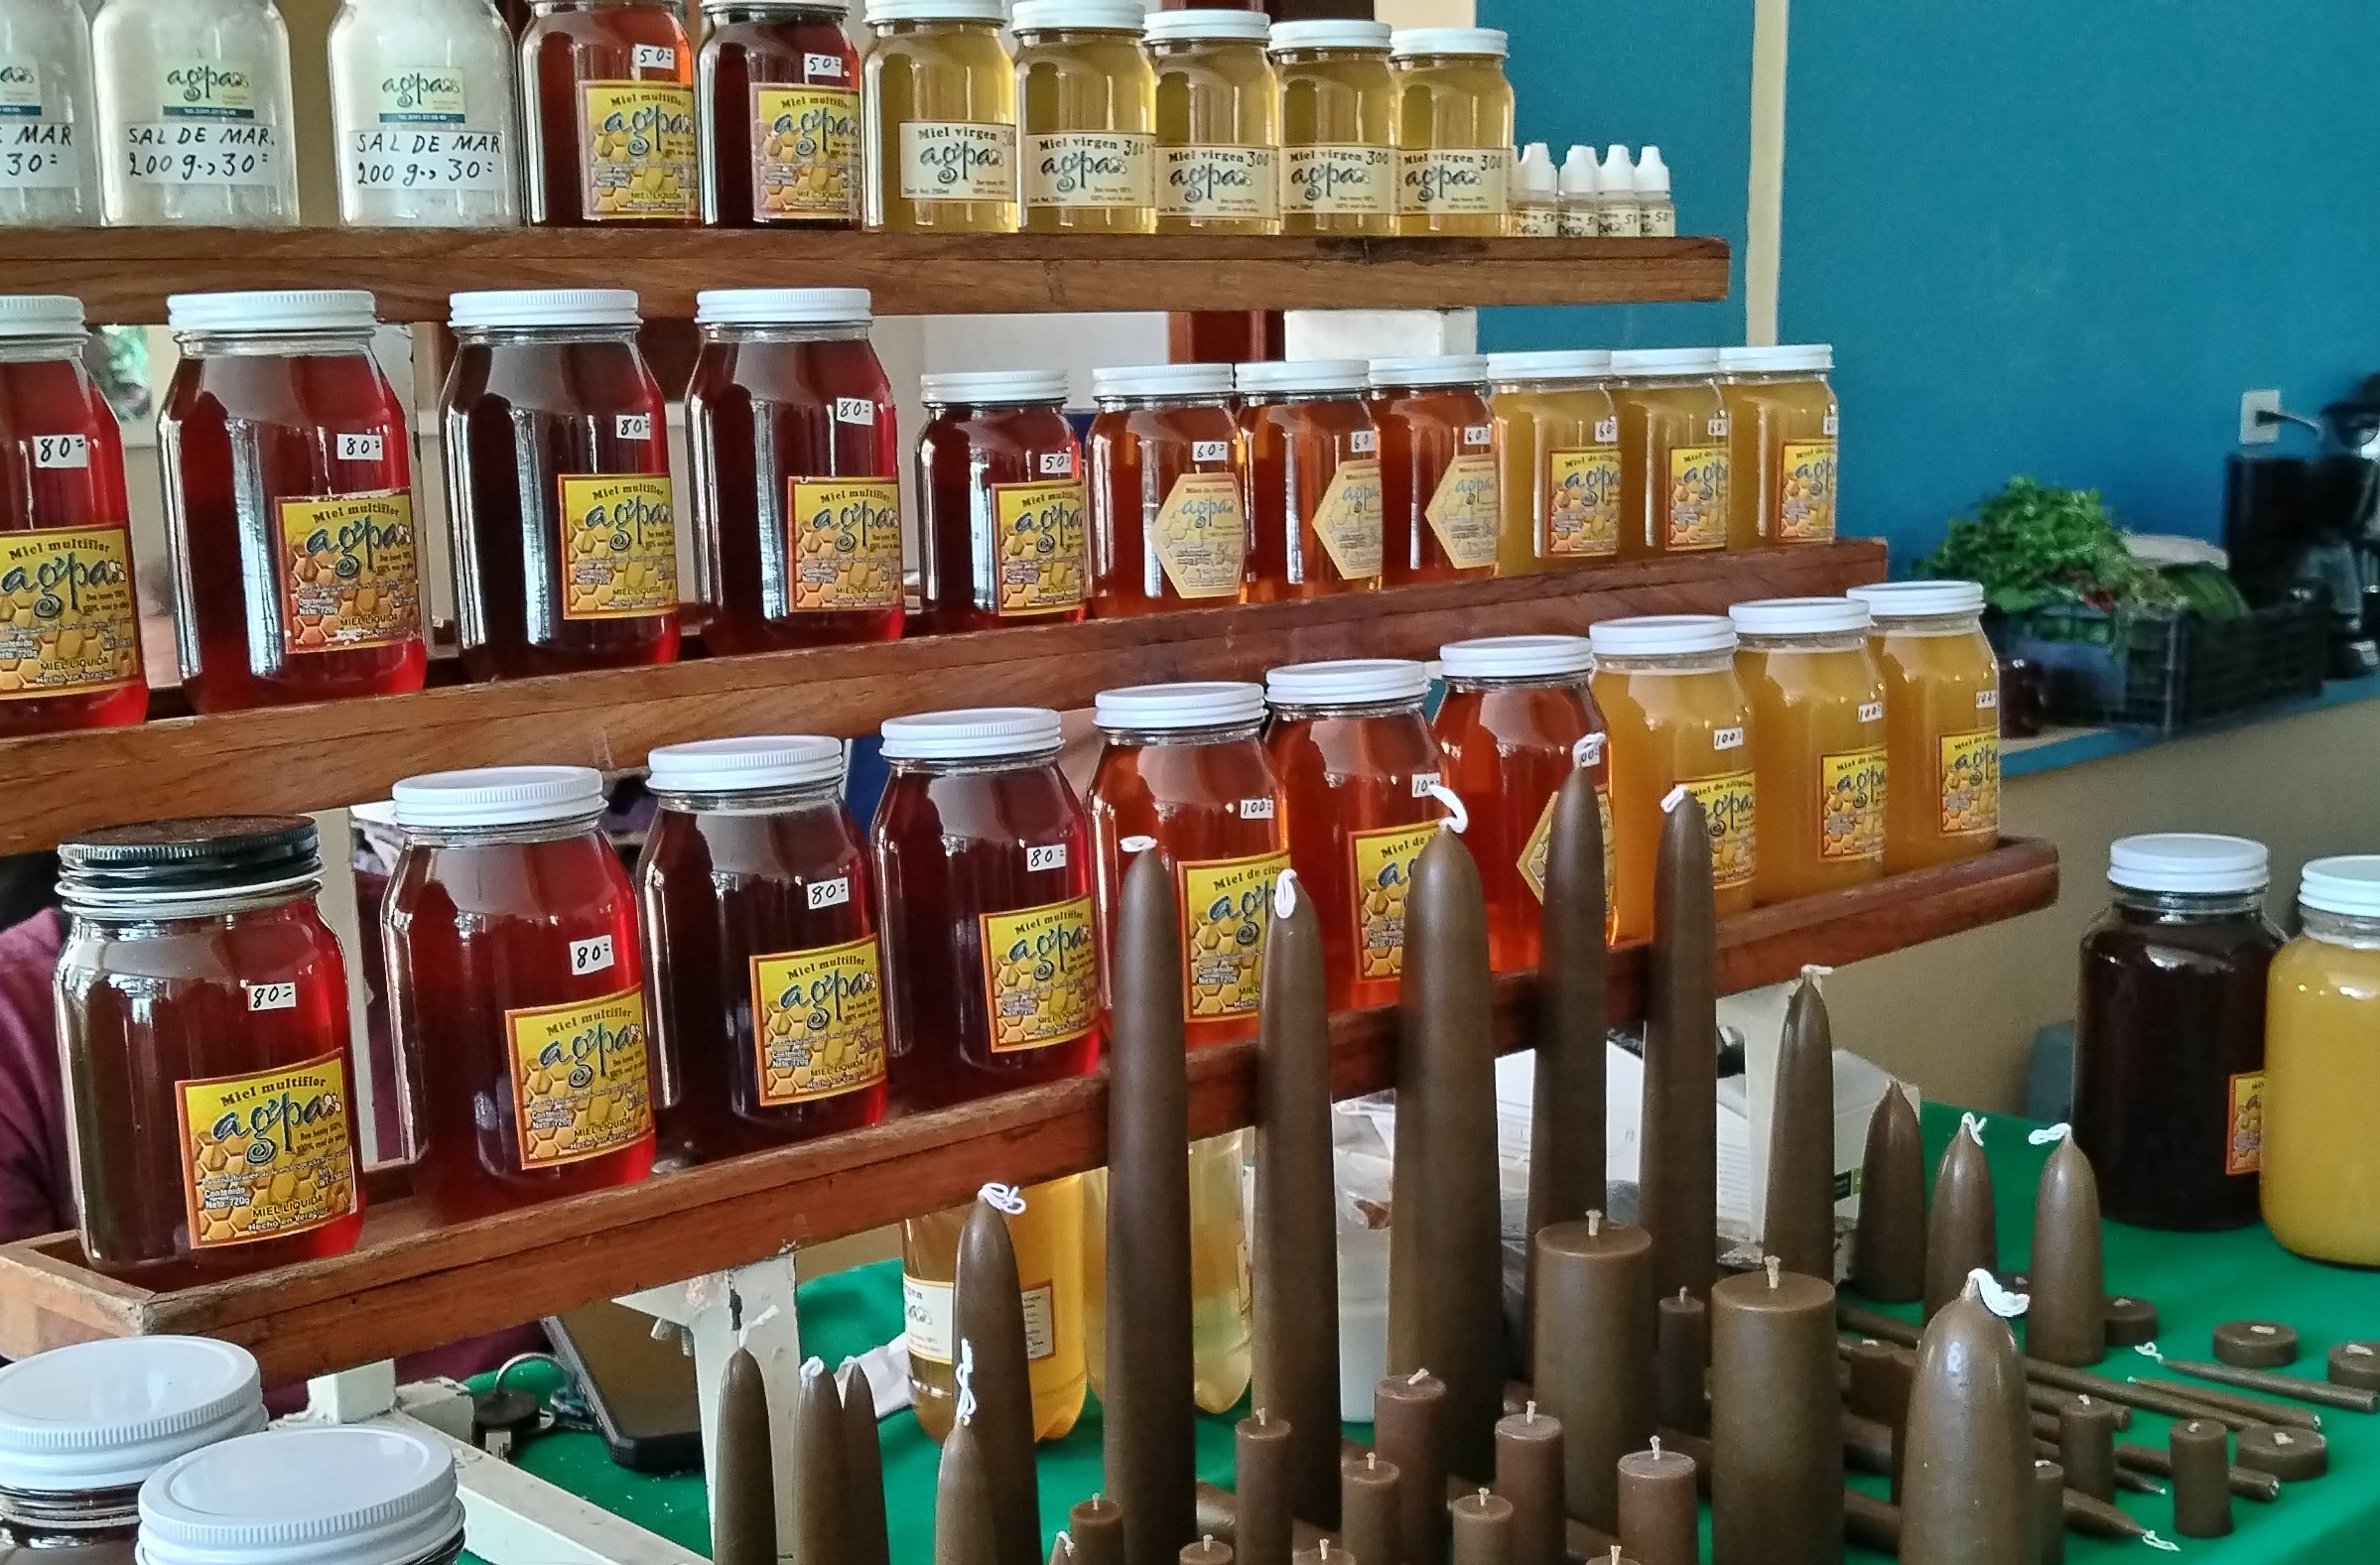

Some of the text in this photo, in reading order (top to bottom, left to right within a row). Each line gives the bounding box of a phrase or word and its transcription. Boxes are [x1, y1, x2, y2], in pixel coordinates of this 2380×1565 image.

[608, 92, 637, 108] Miel
[780, 96, 807, 110] Miel
[14, 125, 71, 147] MAR
[128, 127, 167, 145] SAL
[178, 127, 206, 145] DE
[918, 126, 997, 142] Miel virgen
[356, 133, 500, 154] SAL DE MAR
[1038, 137, 1118, 151] Miel virgen
[1168, 150, 1244, 164] Miel virgen
[1289, 150, 1363, 162] Miel virgen
[1403, 152, 1474, 164] Miel virgen
[128, 154, 173, 177] 200
[357, 162, 394, 185] 200
[1564, 456, 1585, 467] Miel
[1683, 453, 1703, 463] Miel
[592, 484, 619, 500] Miel
[820, 489, 846, 504] Miel
[1021, 494, 1045, 508] Miel
[312, 506, 344, 525] Miel
[8, 542, 44, 561] Miel
[339, 615, 362, 626] MIEL
[41, 661, 66, 672] MIEL
[1953, 739, 1972, 752] Miel
[1836, 759, 1856, 772] Miel
[1380, 836, 1424, 858] Miel de
[1213, 865, 1260, 891] Miel de
[1014, 917, 1040, 936] Miel
[786, 955, 866, 980] Miel multiflor
[546, 1008, 632, 1037] Miel multiflor
[810, 1067, 833, 1079] MIEL
[219, 1076, 327, 1109] Miel multiflor
[574, 1116, 632, 1138] MIEL LIQUIDA
[203, 1186, 245, 1199] Contenido
[229, 1197, 250, 1209] 720g
[252, 1194, 324, 1219] MIEL LIQUIDA
[248, 1221, 279, 1232] Hecho
[281, 1218, 293, 1227] en
